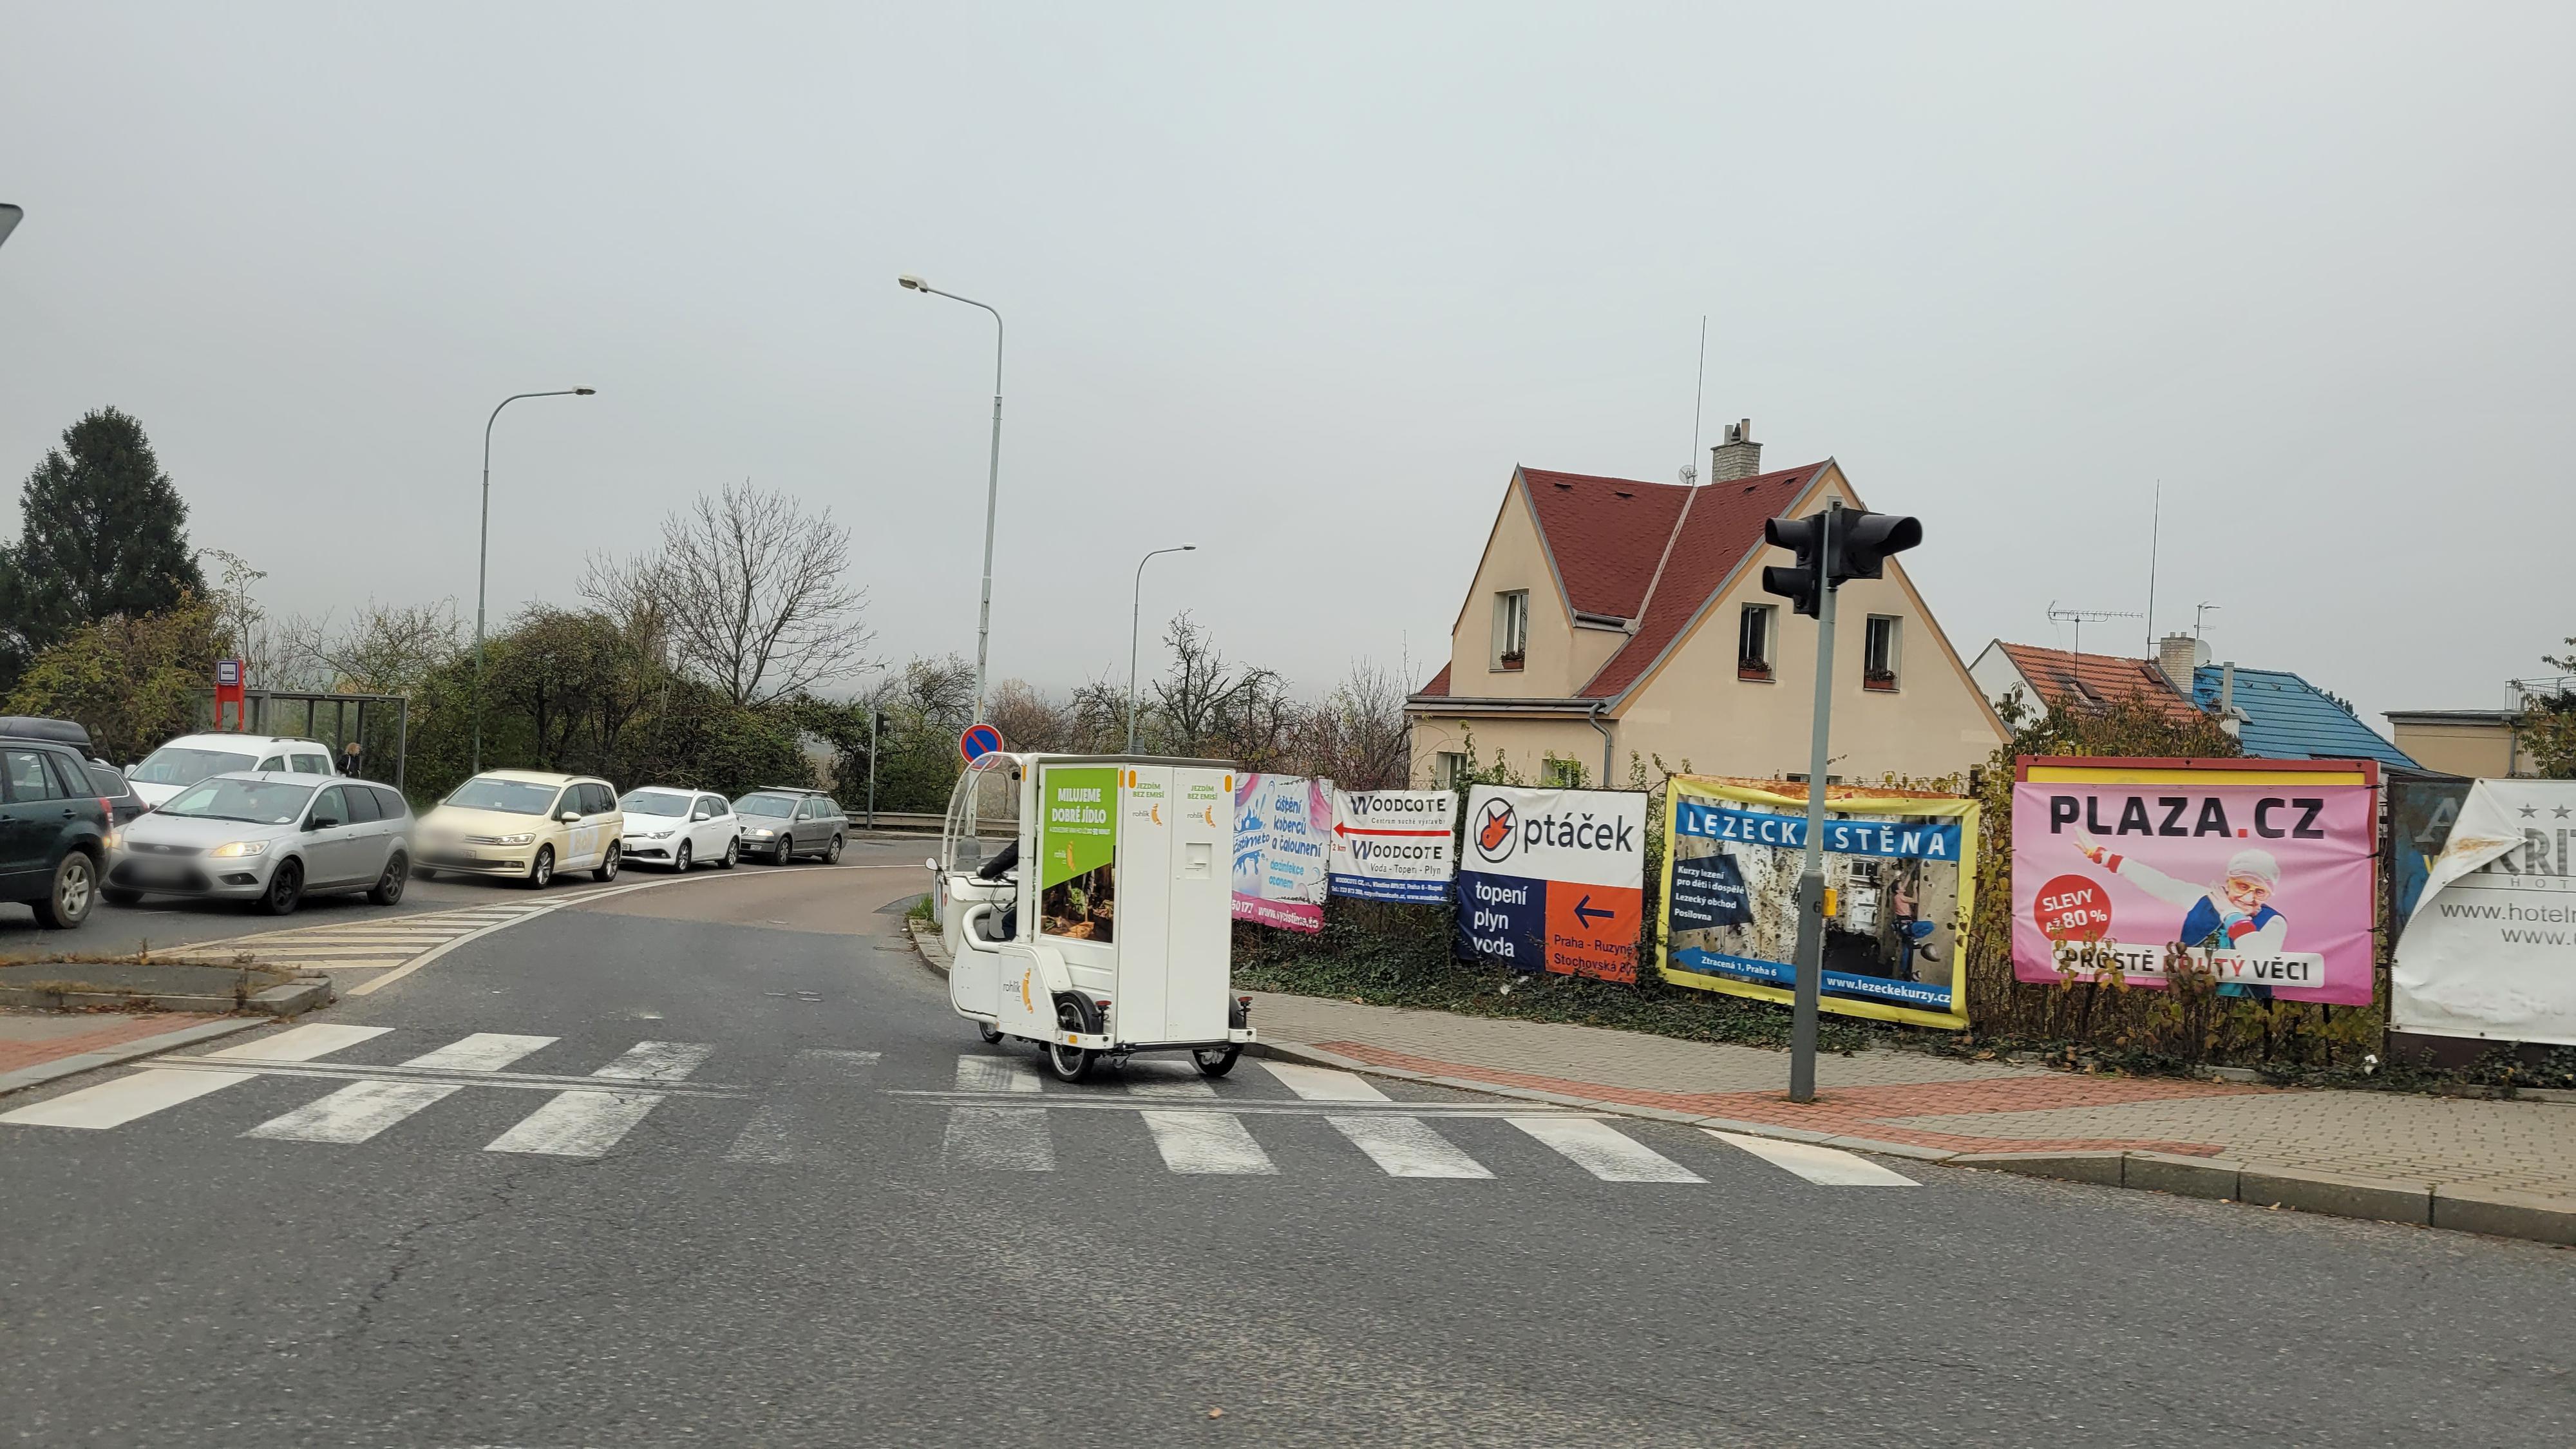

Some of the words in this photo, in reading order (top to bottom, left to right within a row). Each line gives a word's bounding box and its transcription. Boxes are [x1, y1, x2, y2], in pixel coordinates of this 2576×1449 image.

[1057, 788, 1102, 802] MILUJEME
[1350, 795, 1446, 815] WOODCOTE
[1052, 806, 1081, 823] DOBRÉ
[1081, 806, 1106, 824] JÍDLO
[2050, 795, 2325, 840] PLAZA.CZ
[1272, 837, 1278, 849] a
[1524, 812, 1634, 854] ptáček
[1687, 811, 1809, 845] LEZECK
[1835, 826, 1946, 857] STĚNA
[1352, 840, 1443, 860] WOODCOTE
[1370, 863, 1387, 873] Voda
[1425, 865, 1441, 876] Plyn
[1678, 866, 1700, 877] Kurzy
[1701, 869, 1725, 879] lezení
[1475, 881, 1528, 905] topení
[1692, 880, 1707, 889] děti
[1712, 882, 1745, 894] dospělé
[1675, 893, 1707, 905] Lezecký
[1707, 898, 1737, 909] obchod
[2042, 888, 2093, 912] SLEVY
[1473, 908, 1509, 932] plyn
[1674, 908, 1712, 921] Posilovna
[2061, 909, 2087, 929] 80
[2090, 909, 2108, 923] %
[1554, 934, 1584, 949] Praha
[2501, 928, 2576, 945] www.
[1473, 936, 1515, 958] voda
[1554, 953, 1616, 972] Stochovská
[1701, 956, 1735, 969] Ztracená
[1737, 963, 1744, 972] 1,
[1746, 964, 1770, 976] Praha
[2253, 956, 2309, 981] VĚCI
[1826, 977, 1951, 1003] www.lezeckekurzy.cz
